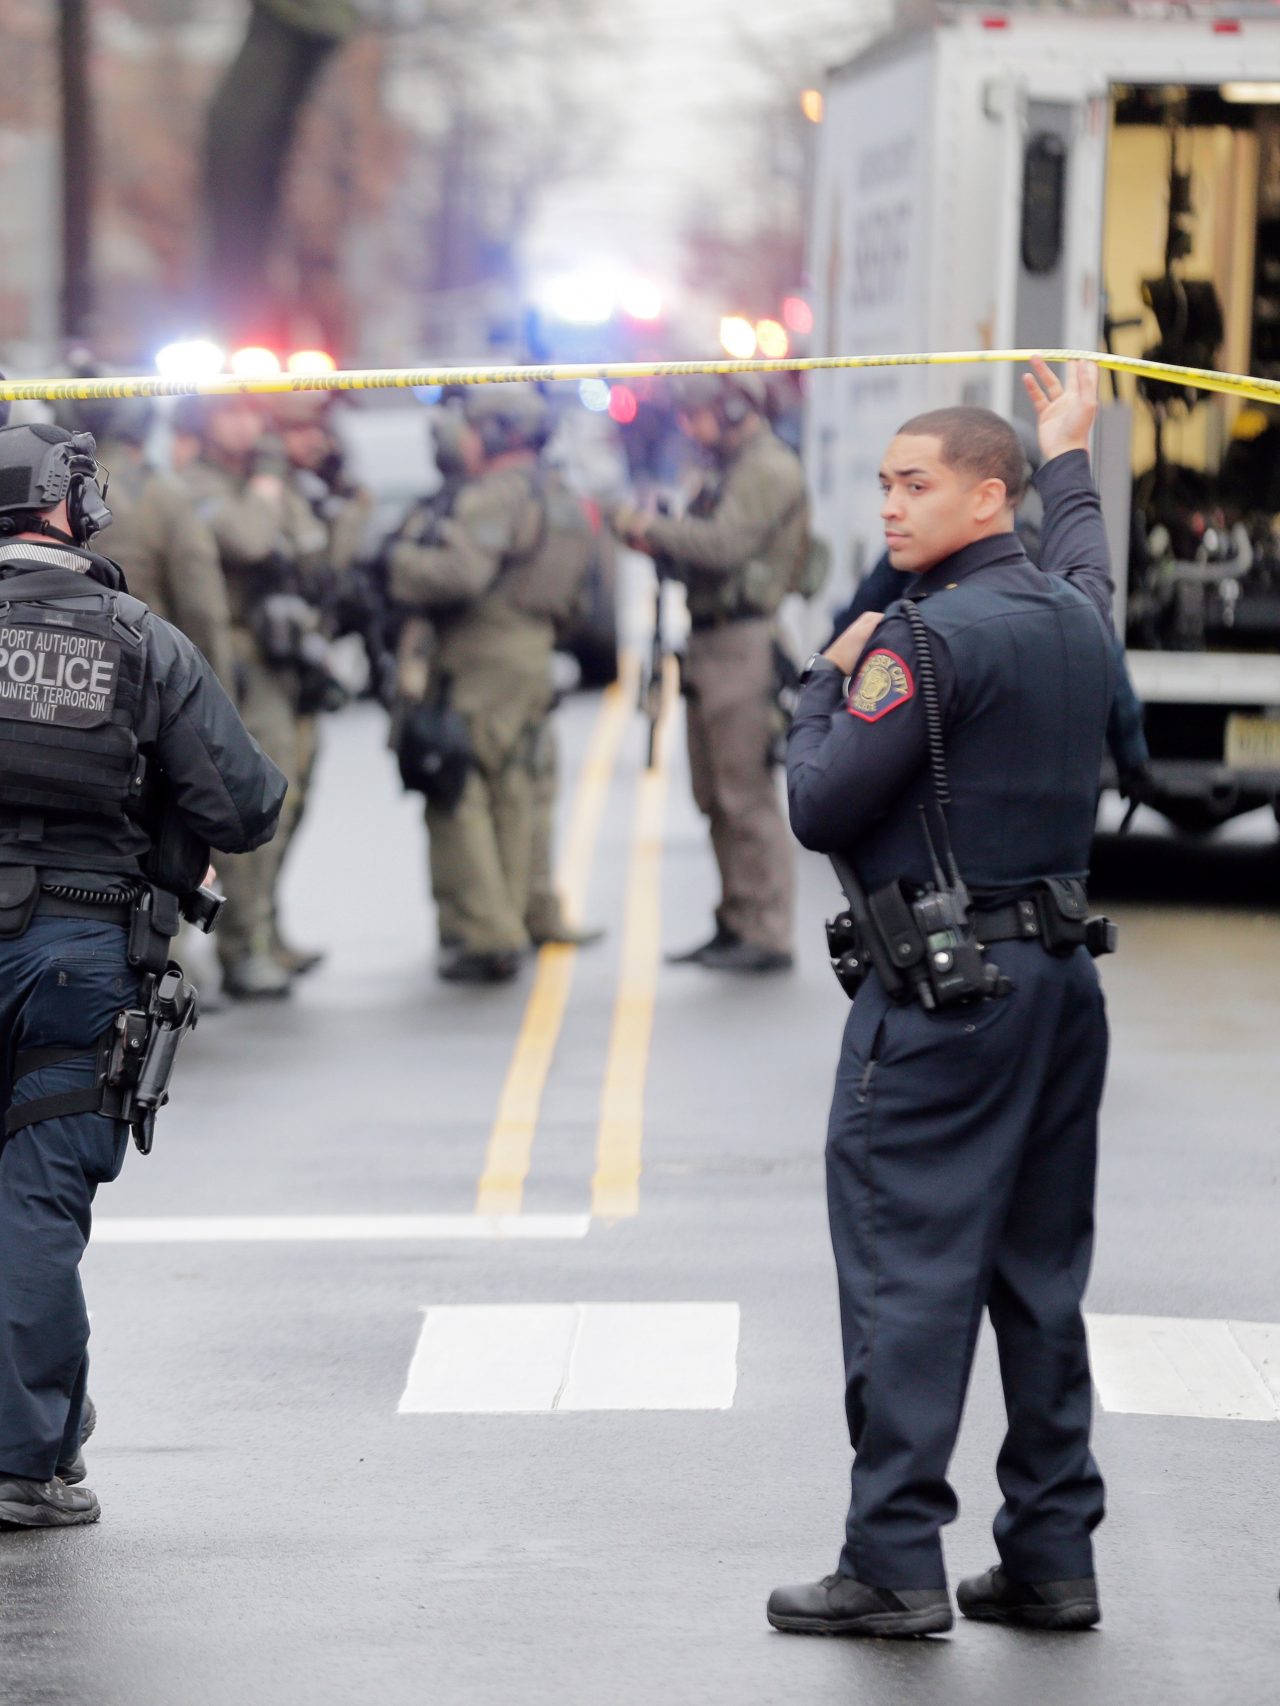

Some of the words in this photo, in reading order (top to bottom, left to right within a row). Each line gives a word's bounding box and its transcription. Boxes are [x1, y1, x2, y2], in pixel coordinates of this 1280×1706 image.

[0, 628, 34, 650] PORT
[34, 632, 106, 660] AUTHORITY
[30, 702, 58, 721] UNIT
[43, 686, 106, 712] TERRORISM
